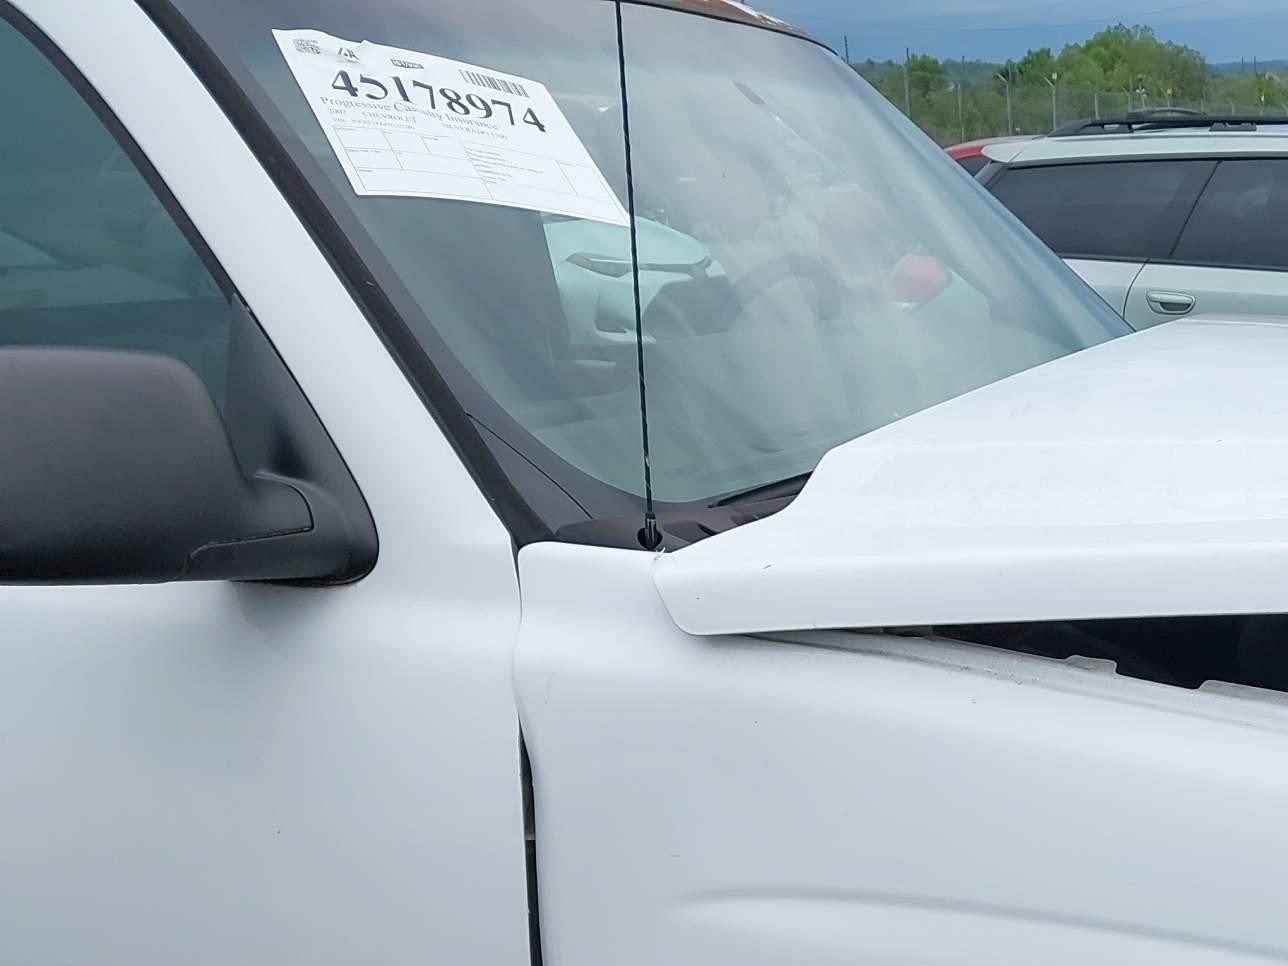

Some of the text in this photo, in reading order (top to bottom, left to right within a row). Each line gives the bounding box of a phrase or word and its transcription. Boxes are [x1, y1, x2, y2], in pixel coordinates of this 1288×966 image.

[320, 96, 391, 111] Progressive
[445, 113, 499, 130] Insurance
[331, 70, 547, 132] 45178974
[361, 111, 416, 123] CHEVROLET
